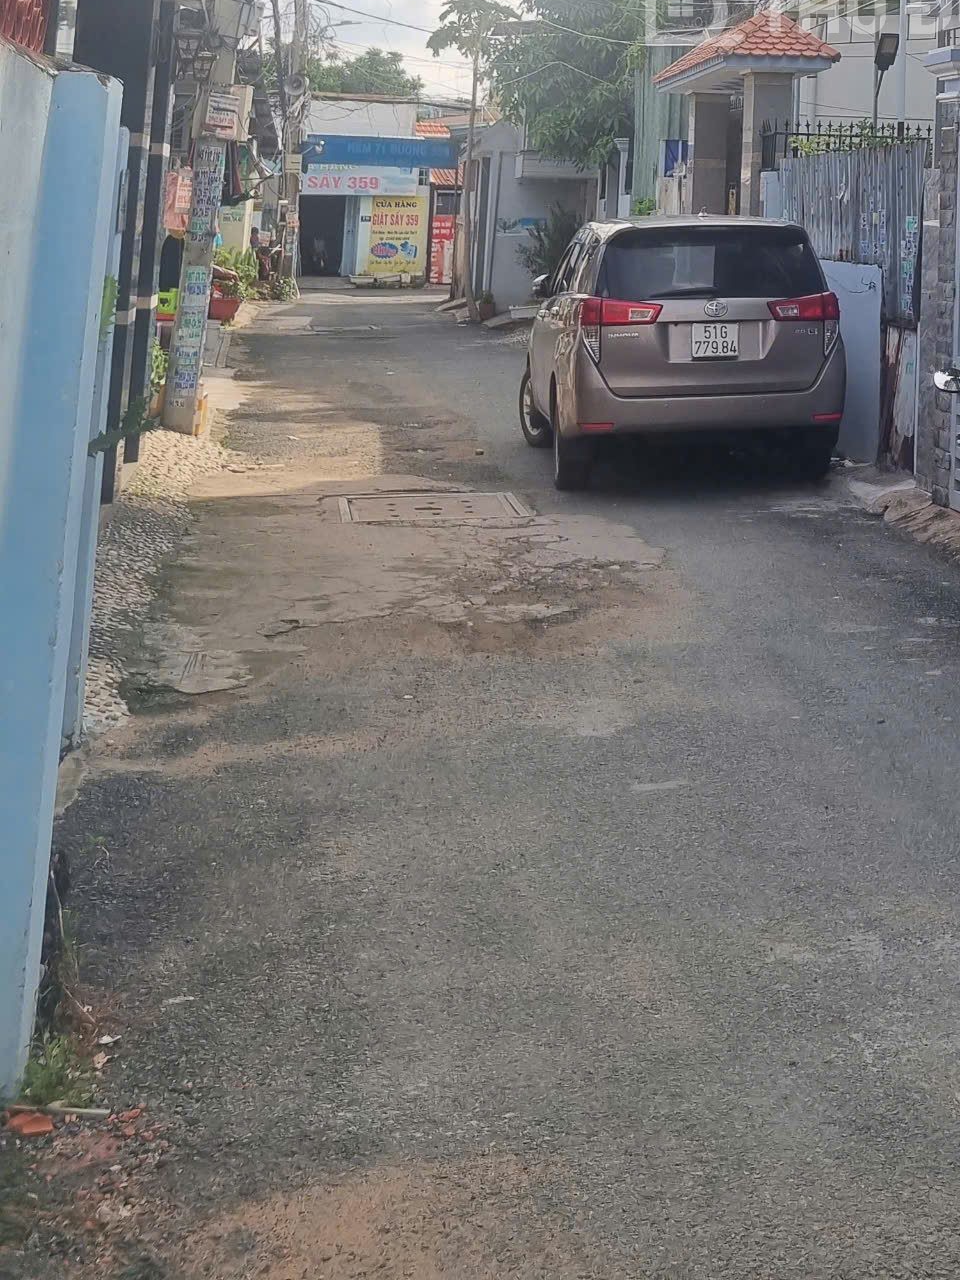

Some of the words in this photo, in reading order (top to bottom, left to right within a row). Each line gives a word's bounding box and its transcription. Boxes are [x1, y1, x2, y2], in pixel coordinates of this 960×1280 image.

[347, 176, 379, 189] 359
[405, 214, 419, 226] 359
[703, 325, 728, 339] 51G
[694, 340, 737, 355] 779.84
